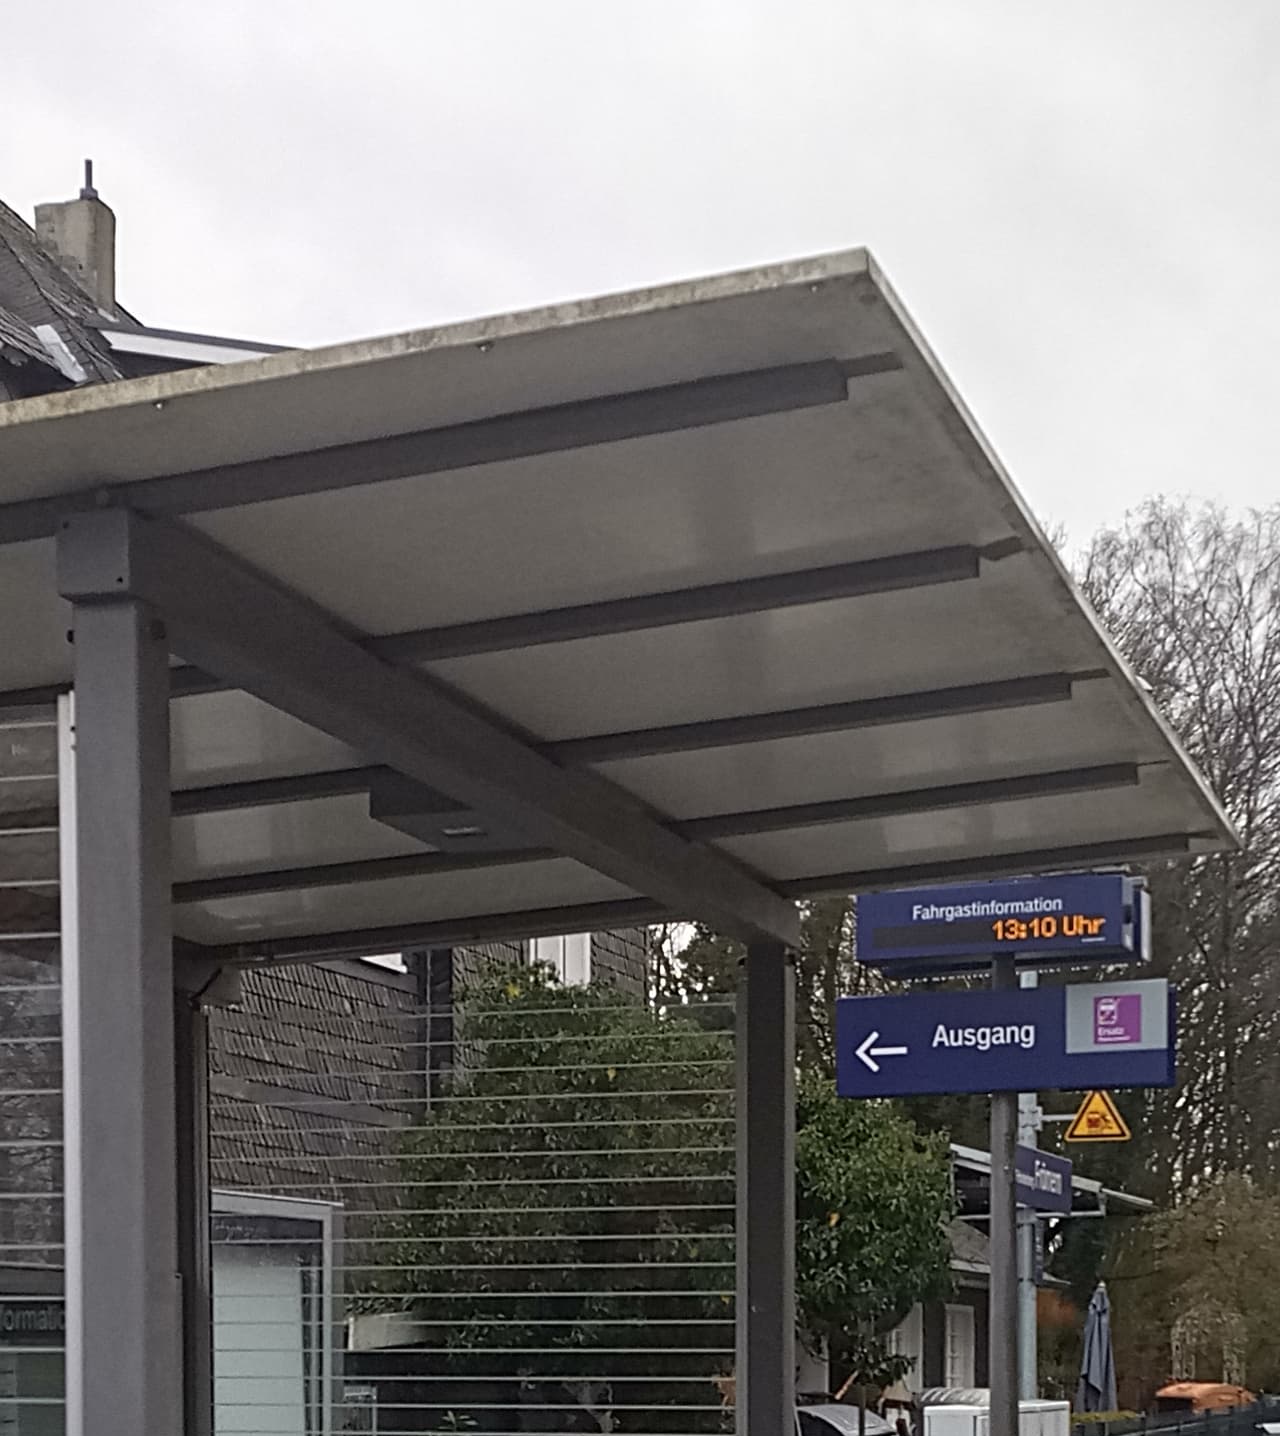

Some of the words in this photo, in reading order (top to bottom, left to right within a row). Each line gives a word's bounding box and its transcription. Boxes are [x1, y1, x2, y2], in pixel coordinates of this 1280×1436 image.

[913, 897, 1062, 921] Fahrgastinformation
[992, 916, 1057, 940] 13:10
[1062, 914, 1107, 937] Uhr
[931, 1023, 1036, 1051] Ausgang
